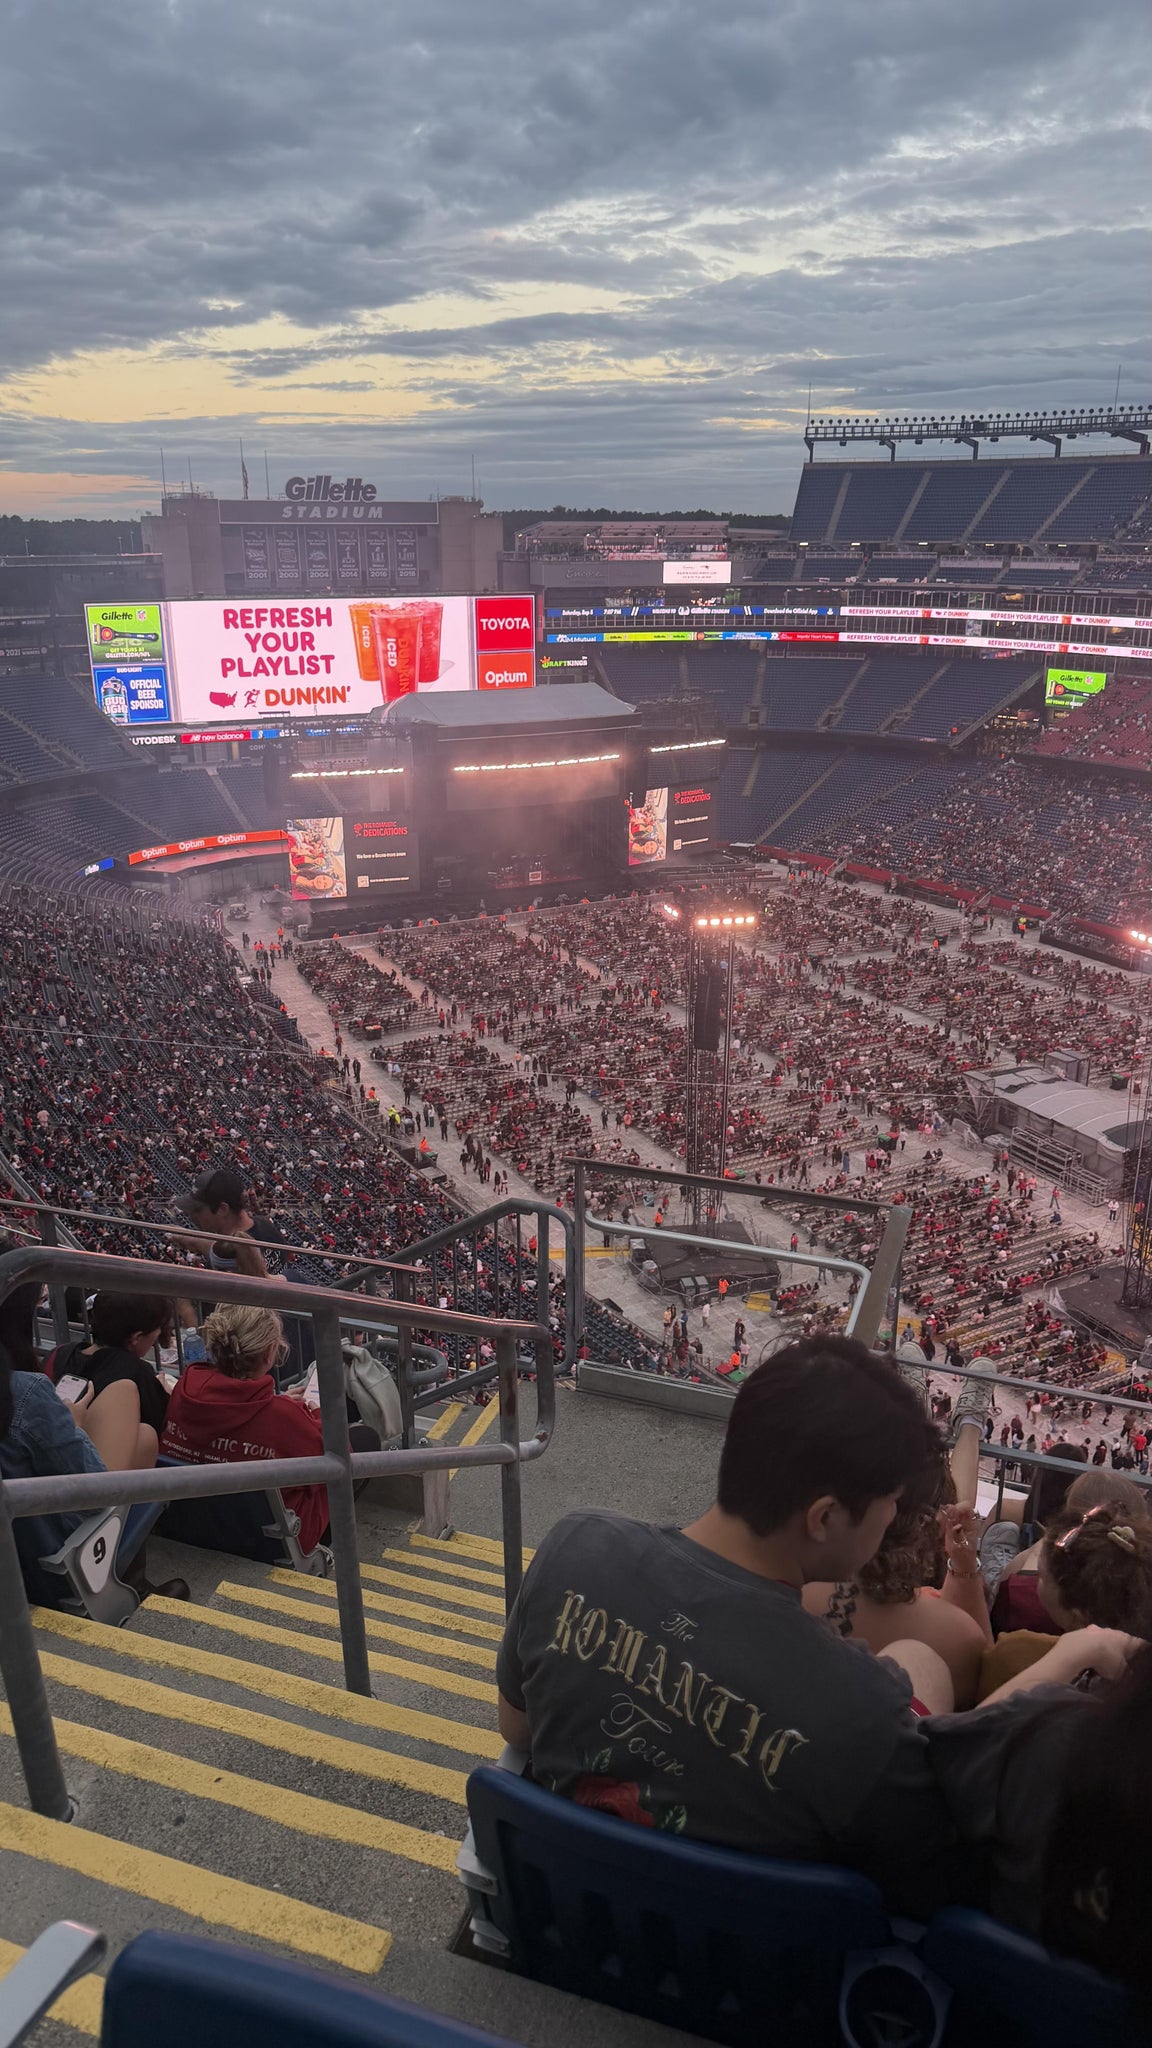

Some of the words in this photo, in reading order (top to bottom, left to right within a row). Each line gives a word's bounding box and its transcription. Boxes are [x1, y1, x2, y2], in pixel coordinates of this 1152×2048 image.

[285, 476, 377, 502] Gillette
[282, 506, 383, 518] STADIUM
[101, 612, 133, 620] Gillette
[223, 607, 332, 629] REFRESH
[480, 617, 530, 631] TOYOTA
[244, 631, 315, 653] YOUR
[362, 626, 370, 648] ICED
[386, 638, 397, 667] ICED
[221, 655, 335, 678] PLAYLIST
[542, 660, 588, 669] DRAFTKINGS
[129, 680, 162, 690] OFFICIAL
[485, 671, 527, 686] Optum
[1060, 675, 1083, 683] Gillette
[137, 690, 156, 699] BEER
[265, 685, 351, 706] DUNKIN'
[130, 700, 164, 710] SPONSOR
[217, 833, 246, 844] Optum
[363, 827, 408, 837] DEDICATIONS
[142, 847, 167, 858] Optum
[179, 840, 204, 851] Optum
[243, 1442, 275, 1459] TOUR
[93, 1536, 106, 1564] 9
[660, 1610, 698, 1641] The
[545, 1589, 810, 1792] ROMANTIC
[600, 1693, 684, 1777] Tour
